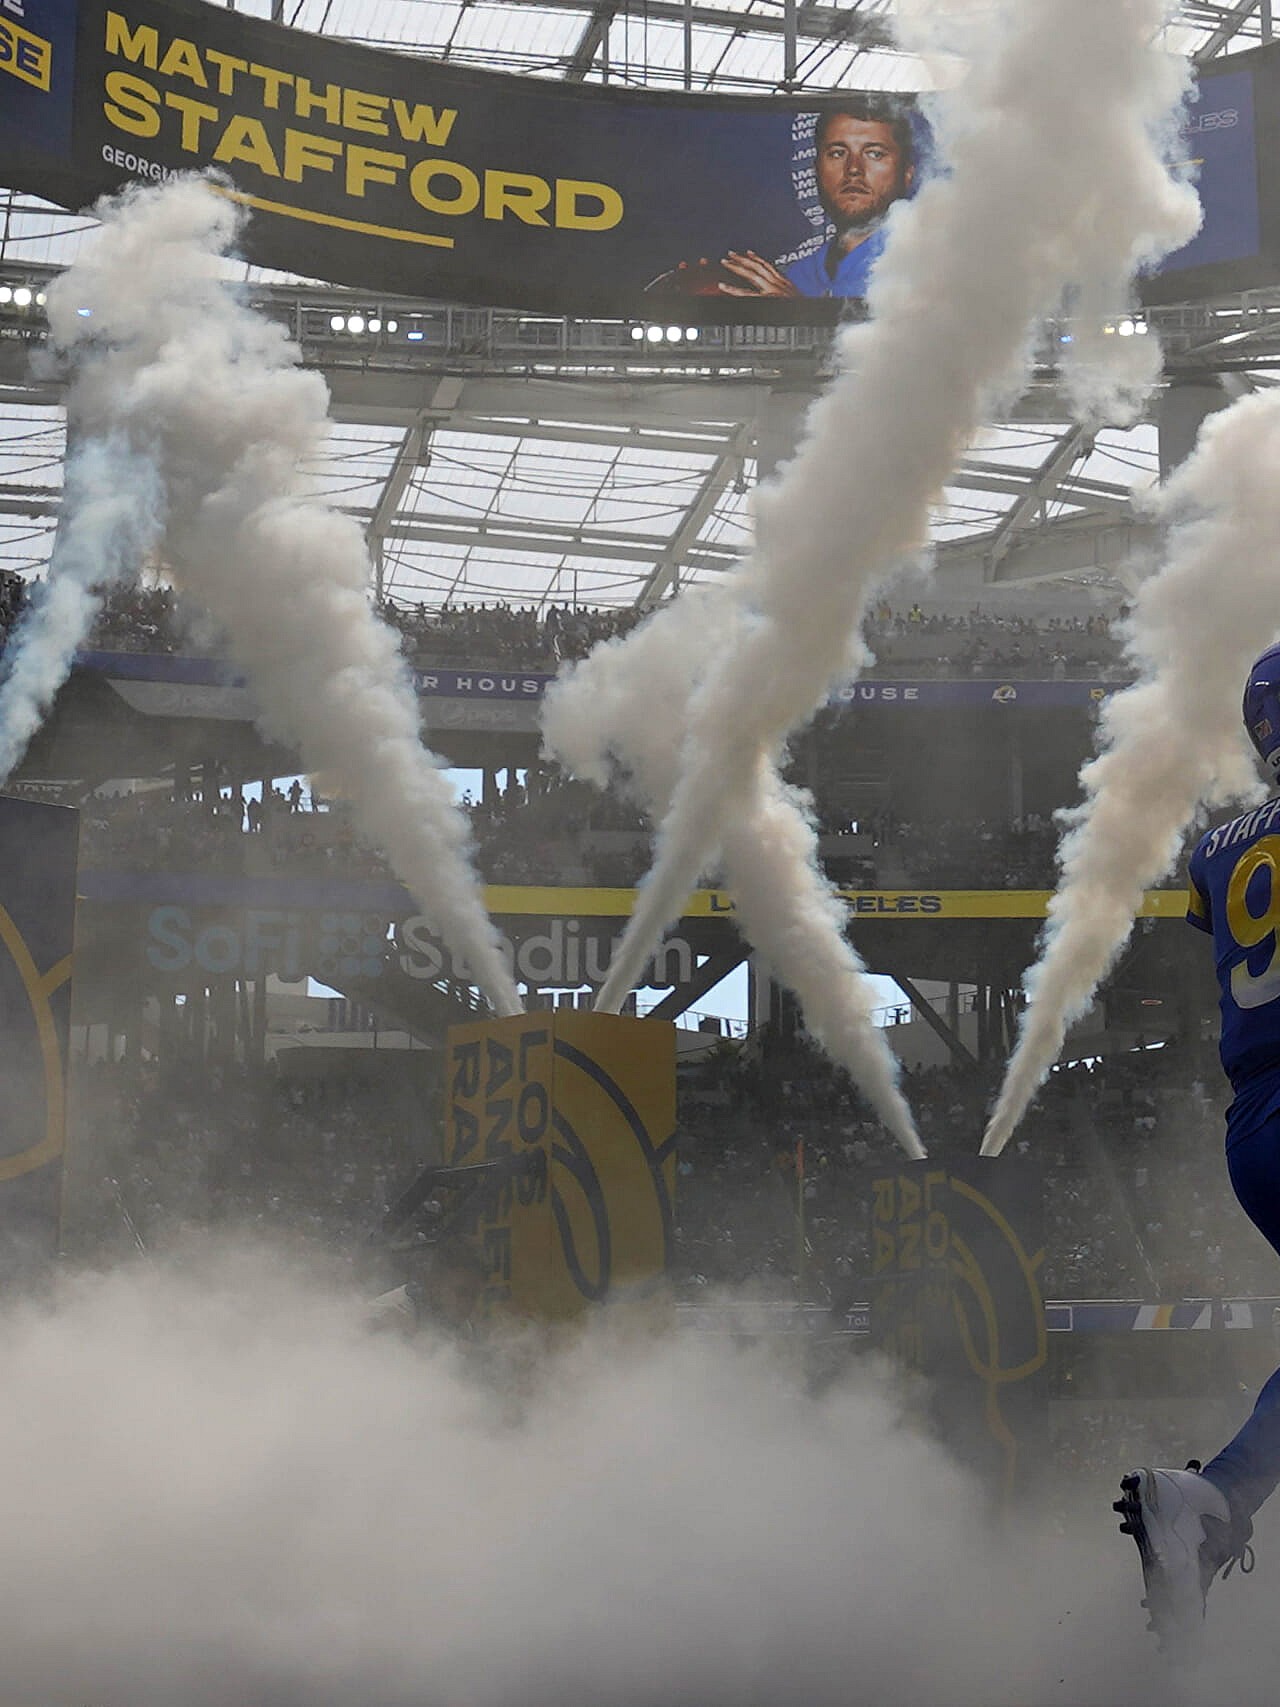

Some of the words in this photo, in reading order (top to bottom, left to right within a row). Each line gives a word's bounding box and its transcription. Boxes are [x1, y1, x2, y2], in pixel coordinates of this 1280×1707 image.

[105, 10, 459, 147] MATTHEW
[102, 70, 625, 232] STAFFORD
[456, 677, 539, 693] HOUS
[838, 687, 919, 701] OUSE
[146, 905, 300, 976] SoFi
[401, 915, 693, 984] Sdium
